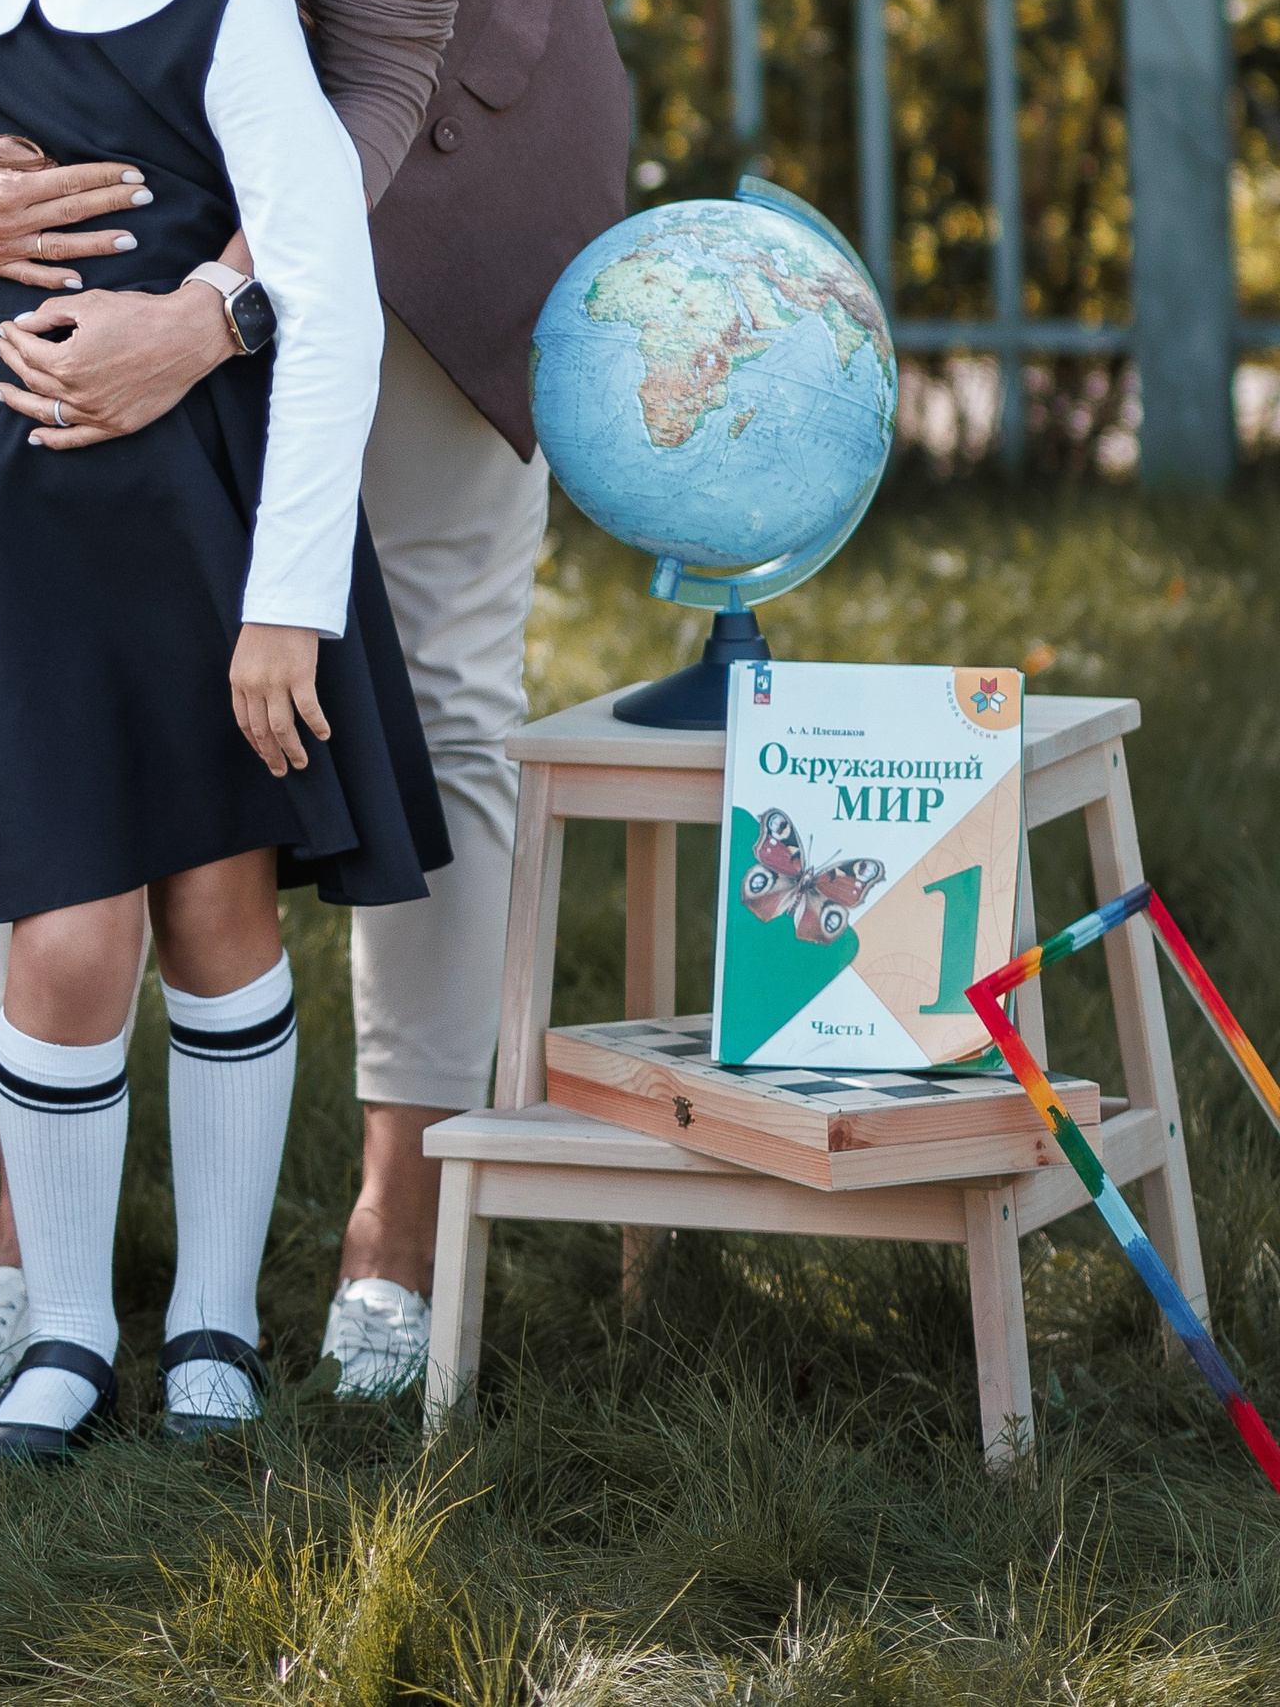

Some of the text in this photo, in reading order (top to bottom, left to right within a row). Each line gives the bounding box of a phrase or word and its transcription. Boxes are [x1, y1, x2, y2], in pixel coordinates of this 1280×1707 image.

[812, 726, 866, 737] Плешаков
[758, 741, 984, 785] Окружающий
[832, 784, 945, 823] МИР
[918, 864, 983, 1015] 1
[810, 1020, 876, 1036] Часть 1
